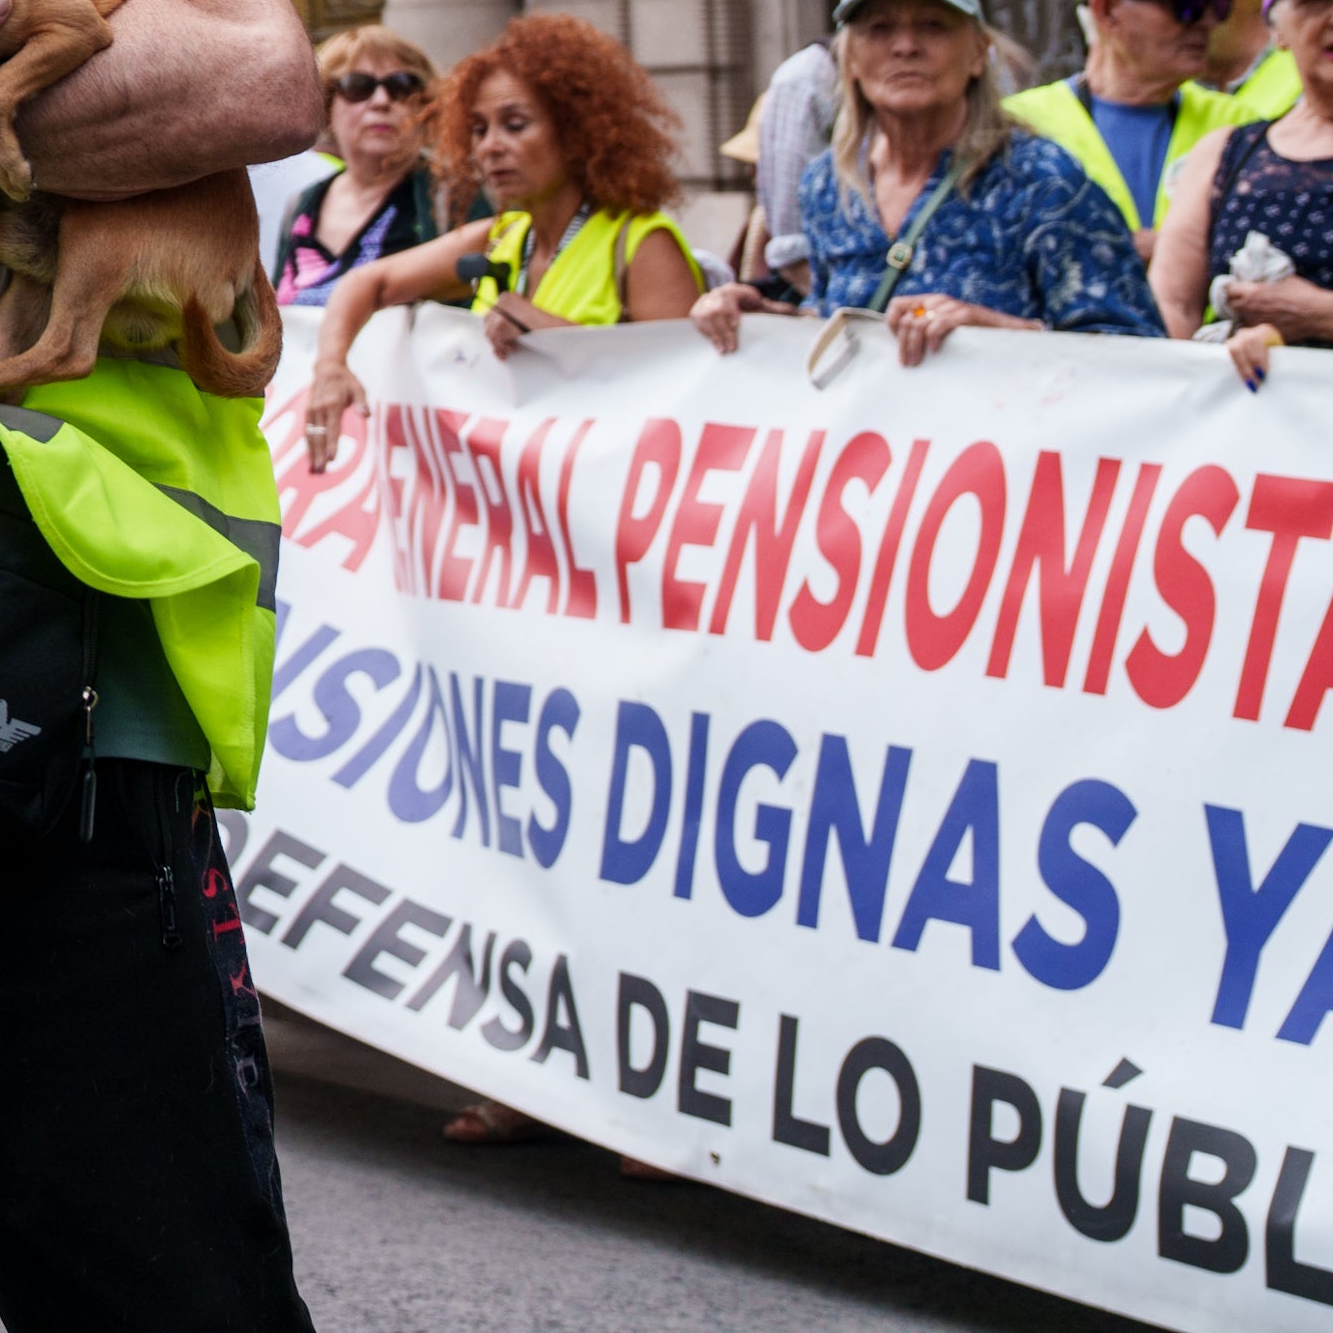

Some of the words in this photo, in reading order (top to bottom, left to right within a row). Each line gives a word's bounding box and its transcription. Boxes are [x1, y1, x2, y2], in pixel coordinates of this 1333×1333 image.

[374, 402, 598, 620] ENERAL
[598, 699, 1139, 991] DIGNAS
[617, 970, 741, 1128] DE
[772, 1012, 922, 1176] LO
[966, 1056, 1333, 1309] PÚBL
